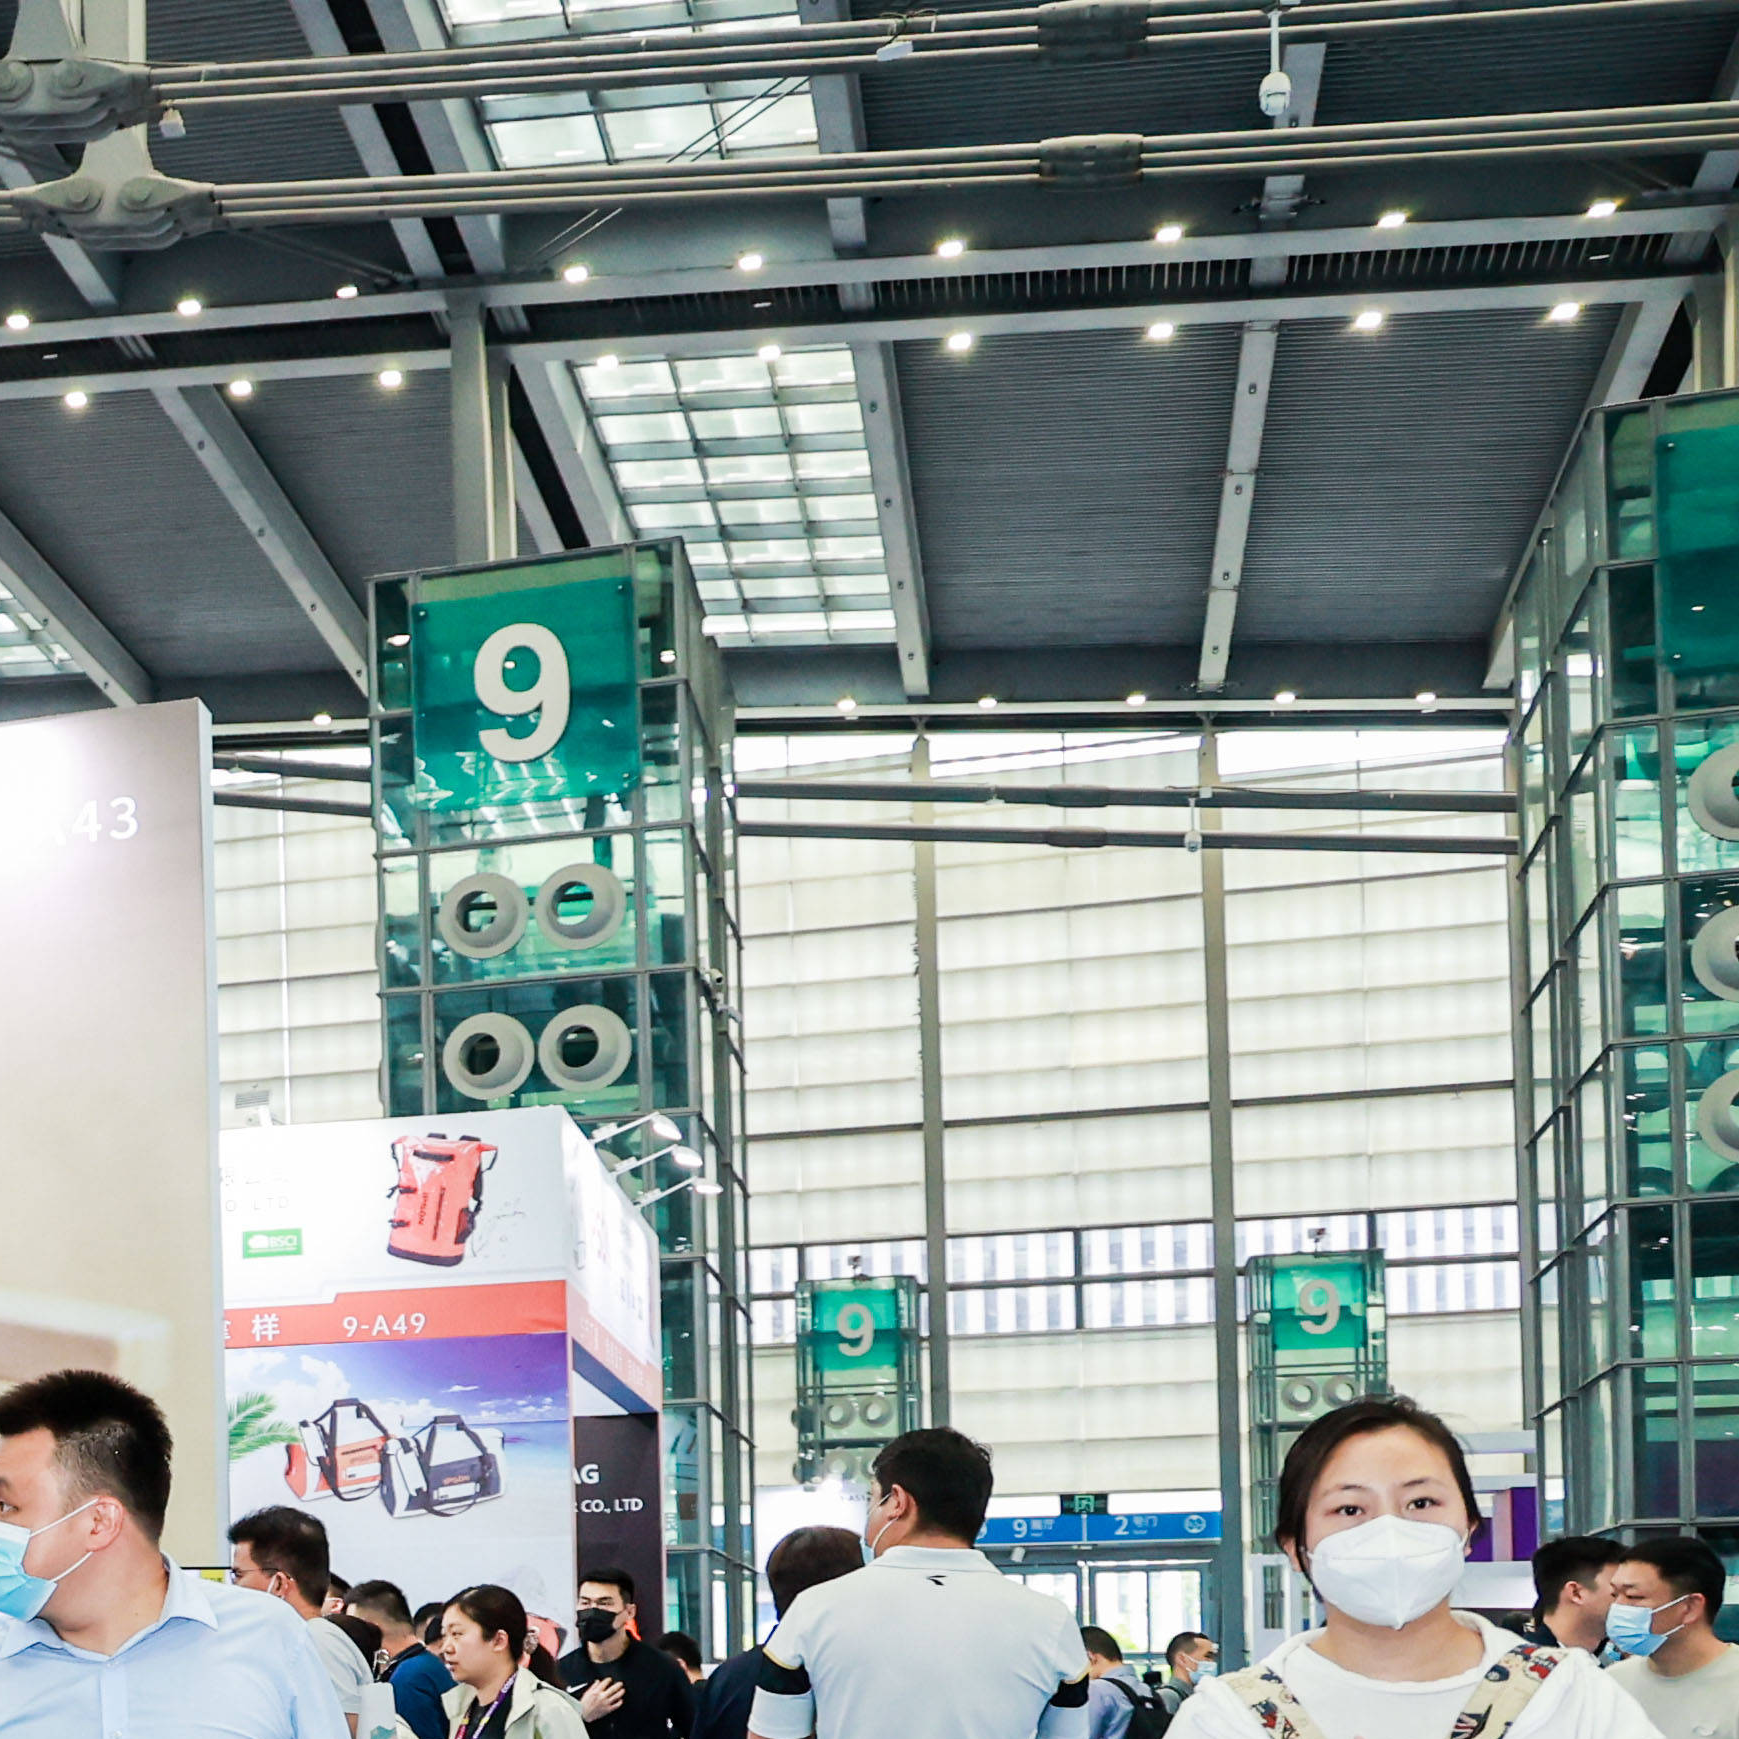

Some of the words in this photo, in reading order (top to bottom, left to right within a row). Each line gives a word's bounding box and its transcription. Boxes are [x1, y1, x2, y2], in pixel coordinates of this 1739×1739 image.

[473, 622, 571, 763] 9
[1299, 1279, 1342, 1336] 9
[342, 1312, 427, 1338] 9-A49
[837, 1303, 875, 1358] 9
[614, 1498, 644, 1512] LTD
[1012, 1519, 1028, 1538] 9
[1114, 1516, 1129, 1536] 2
